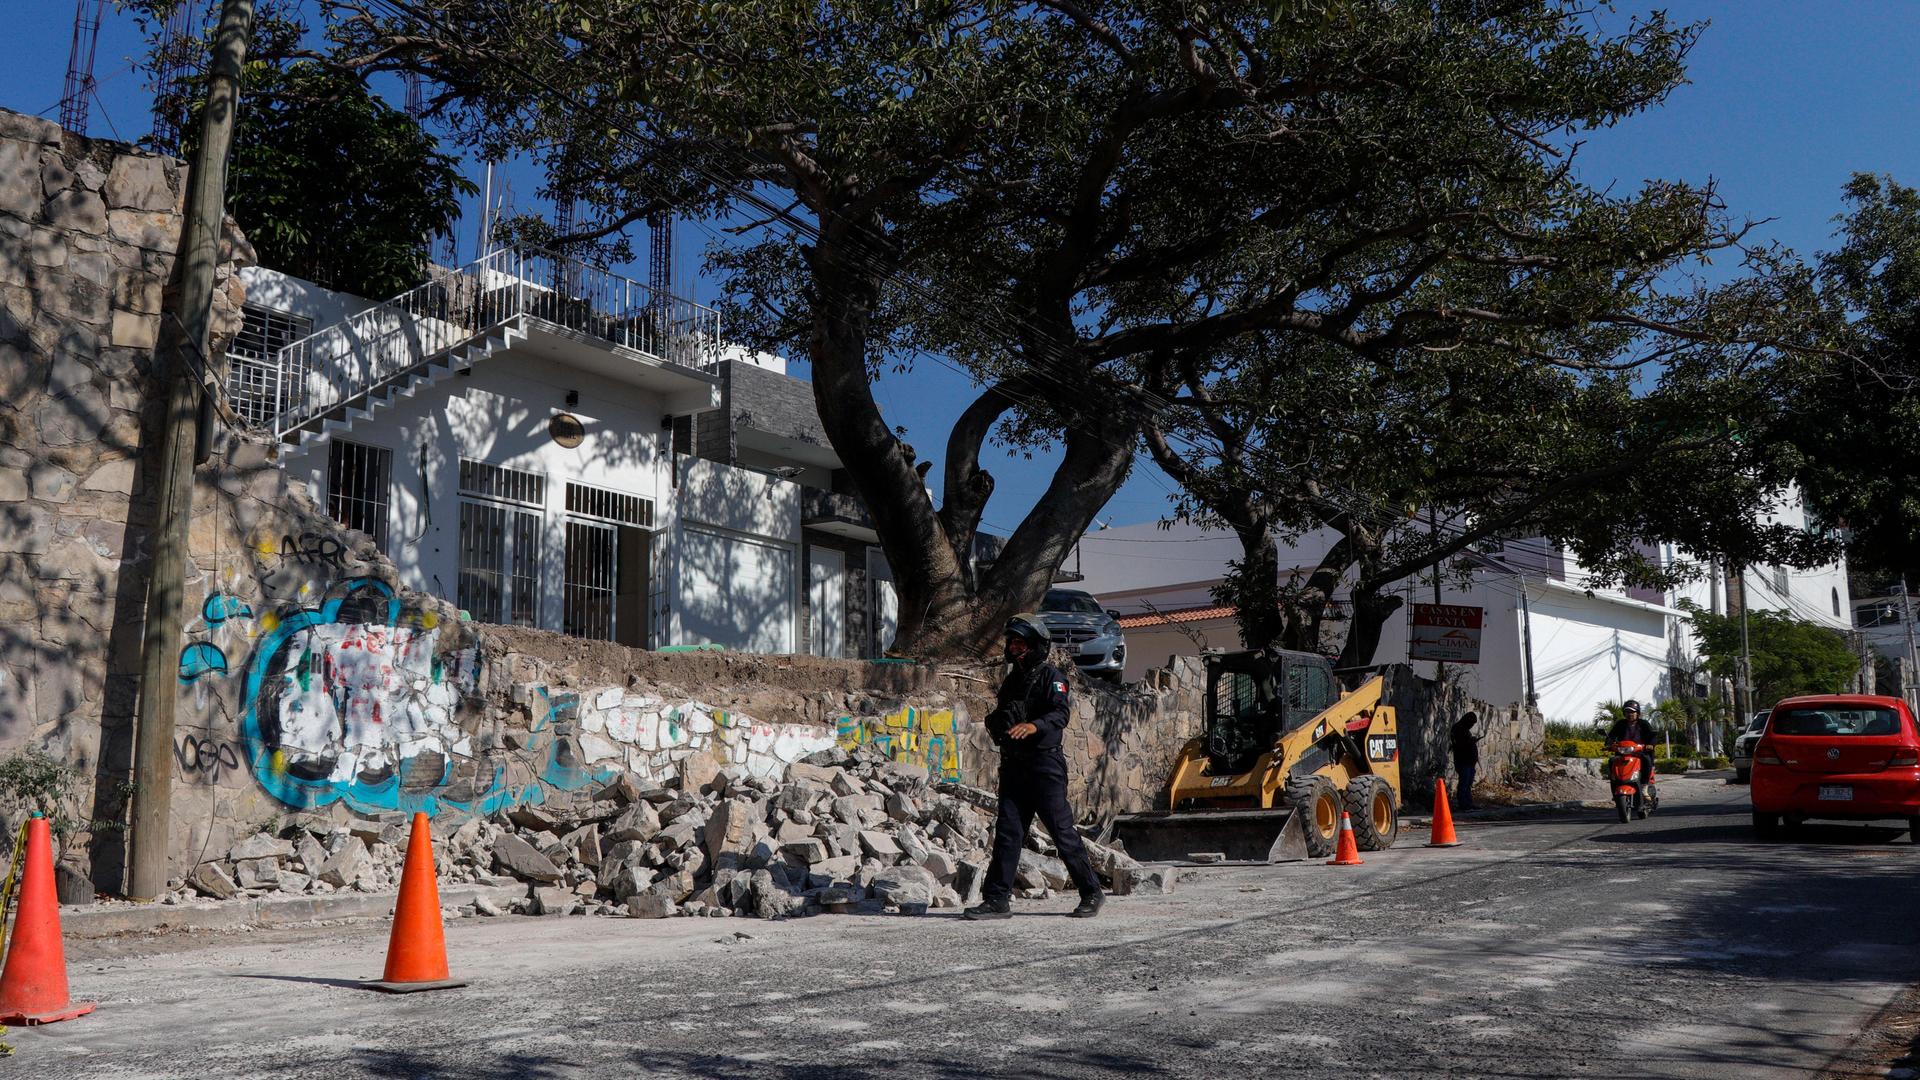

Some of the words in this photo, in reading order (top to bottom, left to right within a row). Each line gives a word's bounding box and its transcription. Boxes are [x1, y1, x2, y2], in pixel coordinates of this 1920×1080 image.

[1420, 605, 1457, 616] CASAS
[1460, 608, 1476, 617] EN
[1428, 616, 1466, 626] VENTA
[1315, 725, 1324, 738] CAT
[1369, 739, 1384, 759] CAT
[1211, 776, 1230, 787] CAT
